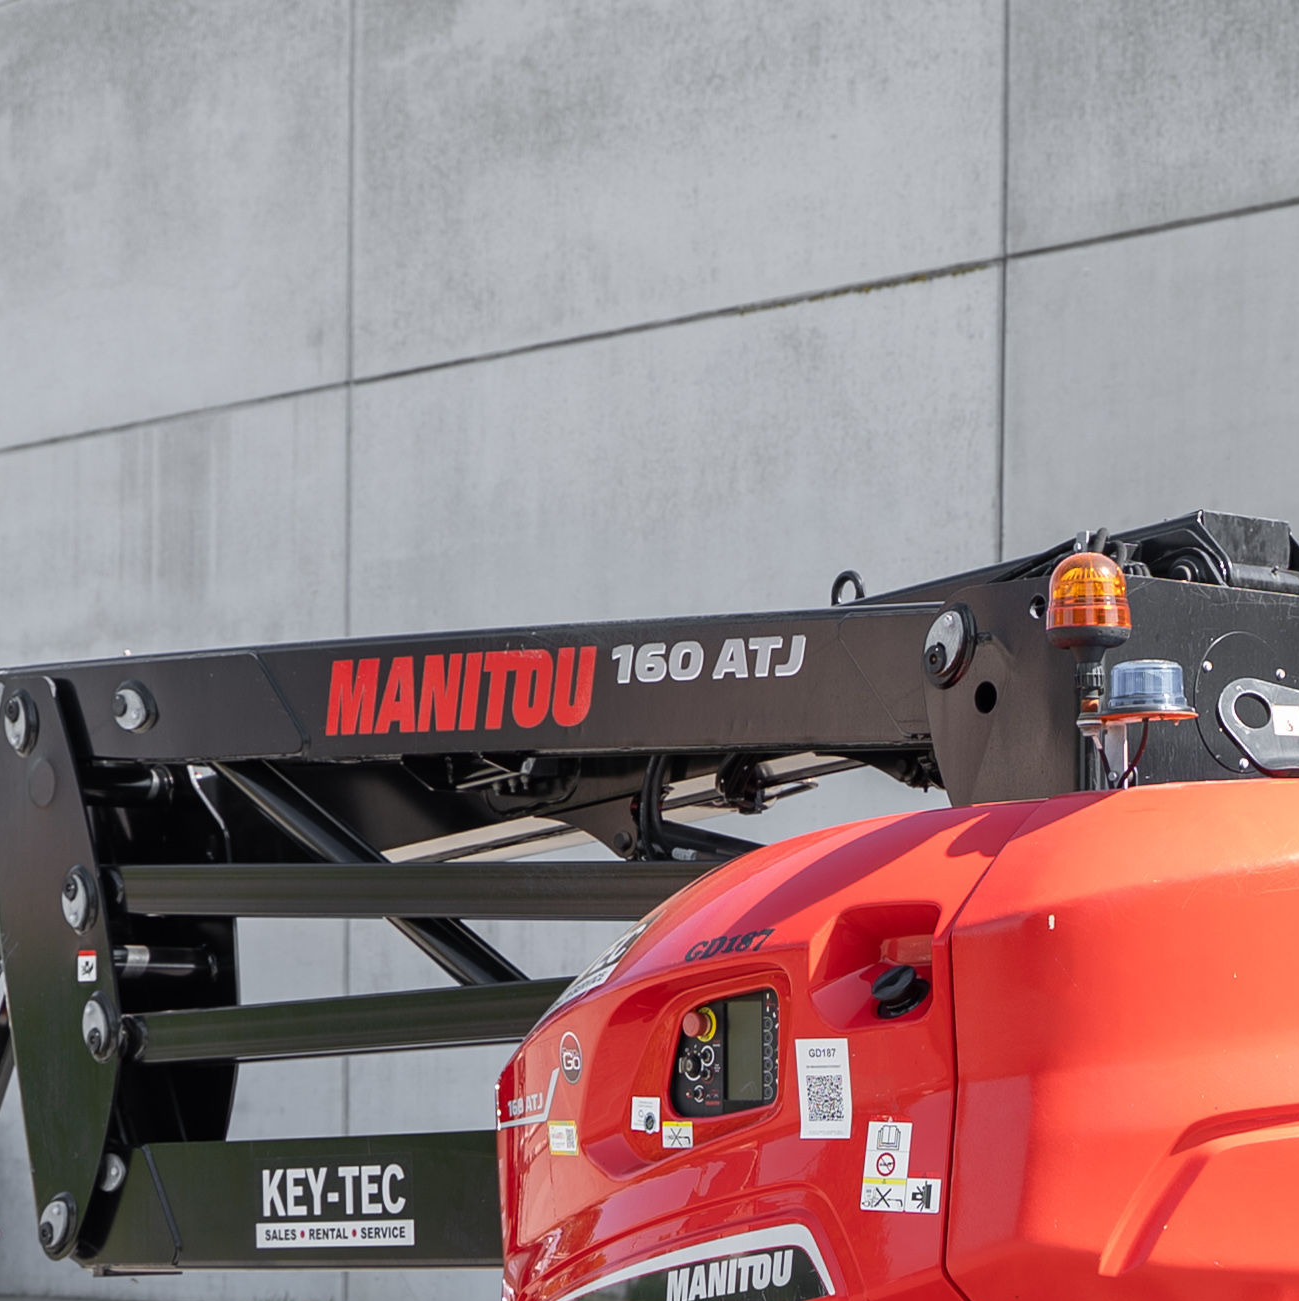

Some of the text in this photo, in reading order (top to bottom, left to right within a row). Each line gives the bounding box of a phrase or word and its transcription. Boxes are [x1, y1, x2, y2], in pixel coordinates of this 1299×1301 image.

[611, 635, 807, 684] 160 ATJ
[325, 645, 597, 736] MANITOU
[684, 928, 775, 962] GD187
[808, 1048, 836, 1058] GD187
[525, 1092, 543, 1112] ATJ
[262, 1163, 406, 1217] KEY-TEC
[265, 1226, 406, 1241] SALES RENTAL SERVICE
